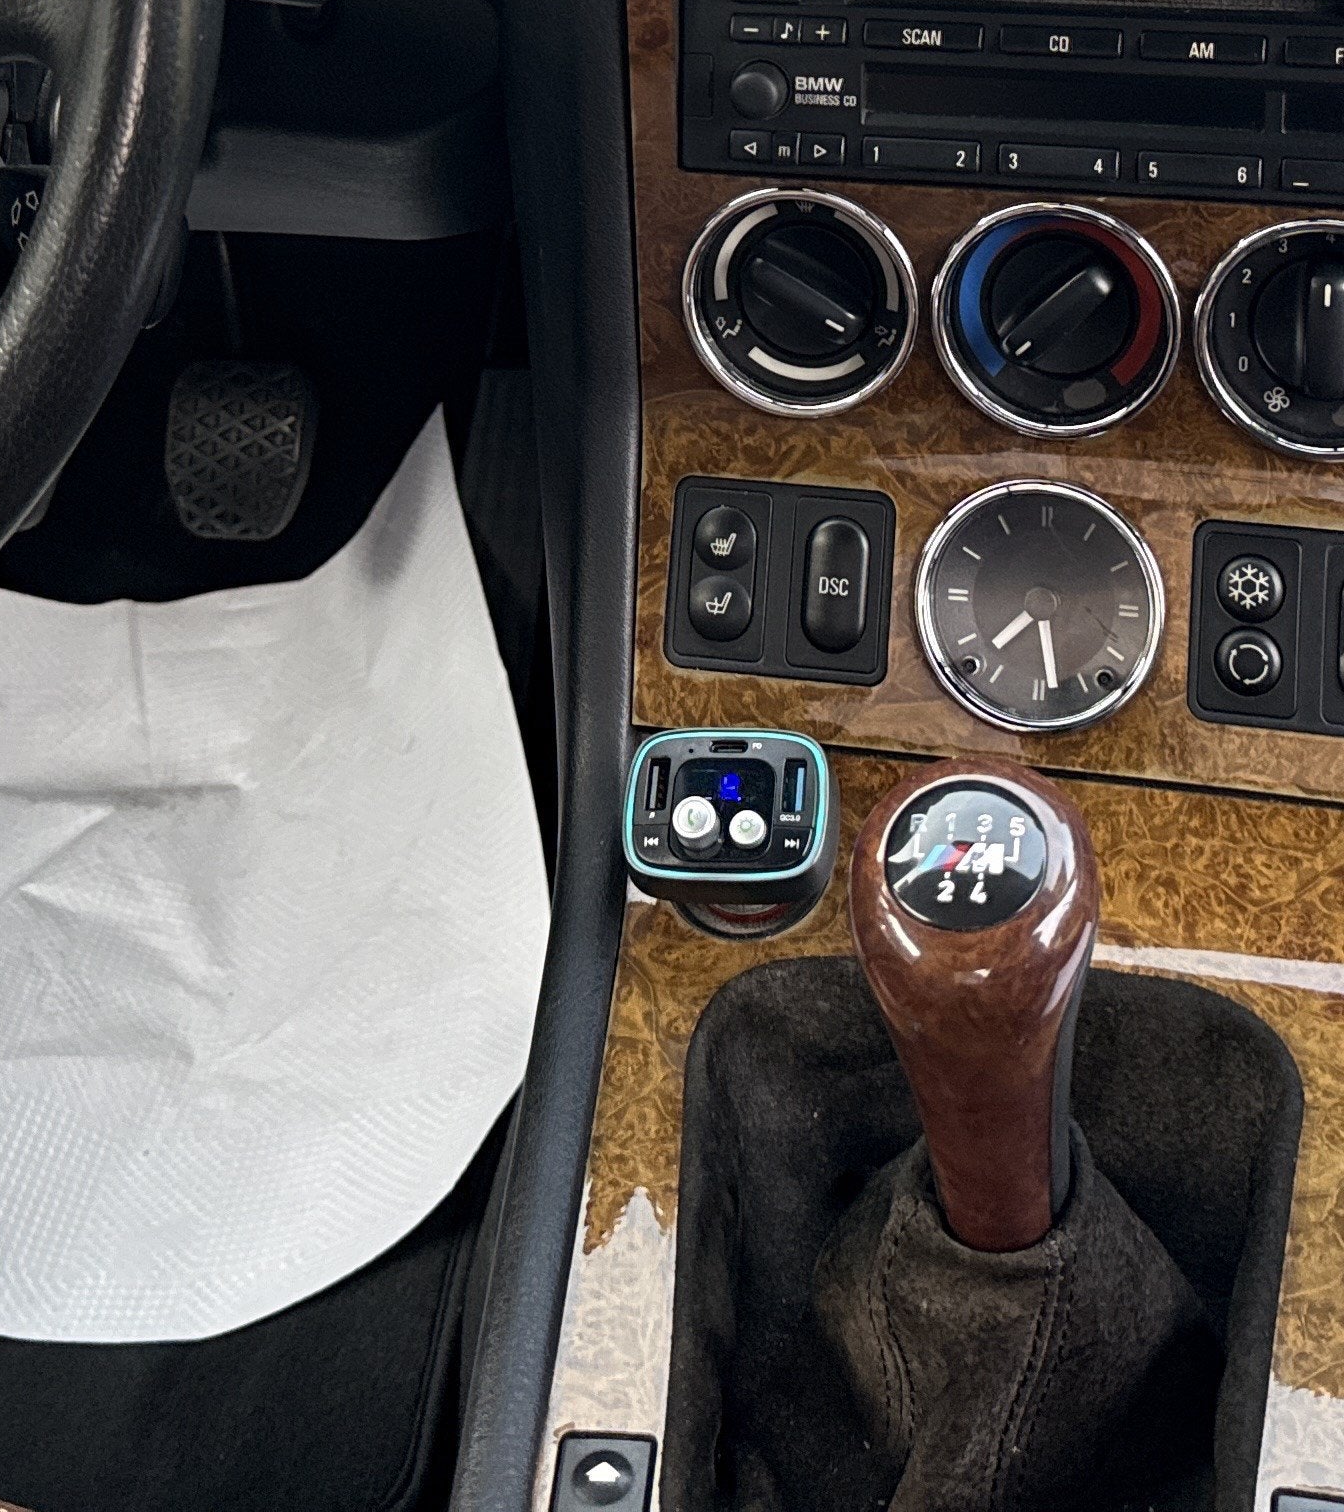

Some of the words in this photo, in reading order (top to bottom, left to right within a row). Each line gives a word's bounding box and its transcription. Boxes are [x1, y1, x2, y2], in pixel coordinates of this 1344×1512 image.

[902, 28, 942, 47] SCAN
[1049, 35, 1069, 53] CD
[1188, 42, 1214, 59] AM
[794, 76, 844, 92] BMW
[794, 93, 841, 107] BUSINESS
[843, 95, 857, 107] CD
[778, 145, 791, 157] m
[873, 145, 880, 164] 1
[955, 150, 966, 168] 2
[1008, 152, 1019, 170] 3
[1093, 158, 1103, 174] 4
[1148, 161, 1158, 178] 5
[1237, 166, 1247, 184] 6
[1278, 238, 1288, 253] 3
[1242, 268, 1252, 284] 2
[1229, 312, 1236, 328] 1
[1238, 356, 1248, 372] 0
[818, 577, 849, 597] DSC
[910, 813, 928, 833] R
[945, 812, 956, 832] 1
[977, 813, 993, 833] 3
[1009, 816, 1026, 836] 5
[937, 879, 955, 903] 2
[970, 881, 987, 904] 4
